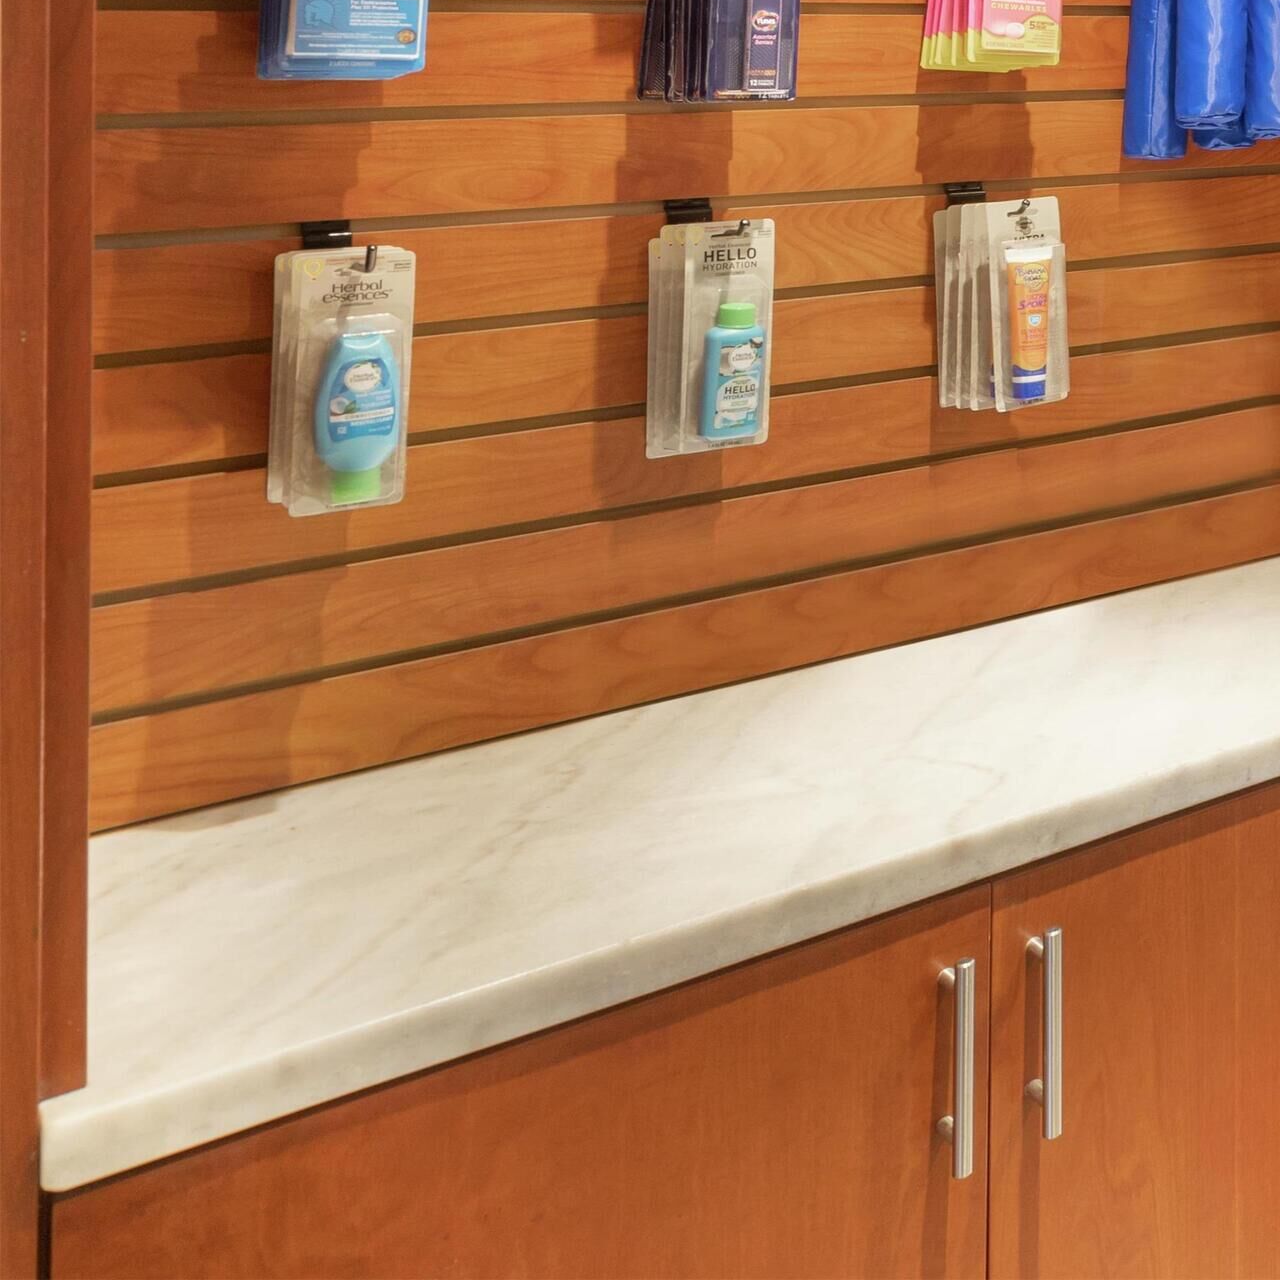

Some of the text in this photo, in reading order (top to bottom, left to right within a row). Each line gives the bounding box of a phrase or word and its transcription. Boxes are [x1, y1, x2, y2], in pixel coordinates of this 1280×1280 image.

[704, 246, 758, 263] HELLO
[702, 260, 759, 272] HYDRATION
[331, 278, 384, 295] Herbal
[322, 288, 390, 305] essences
[724, 383, 756, 395] HELLO
